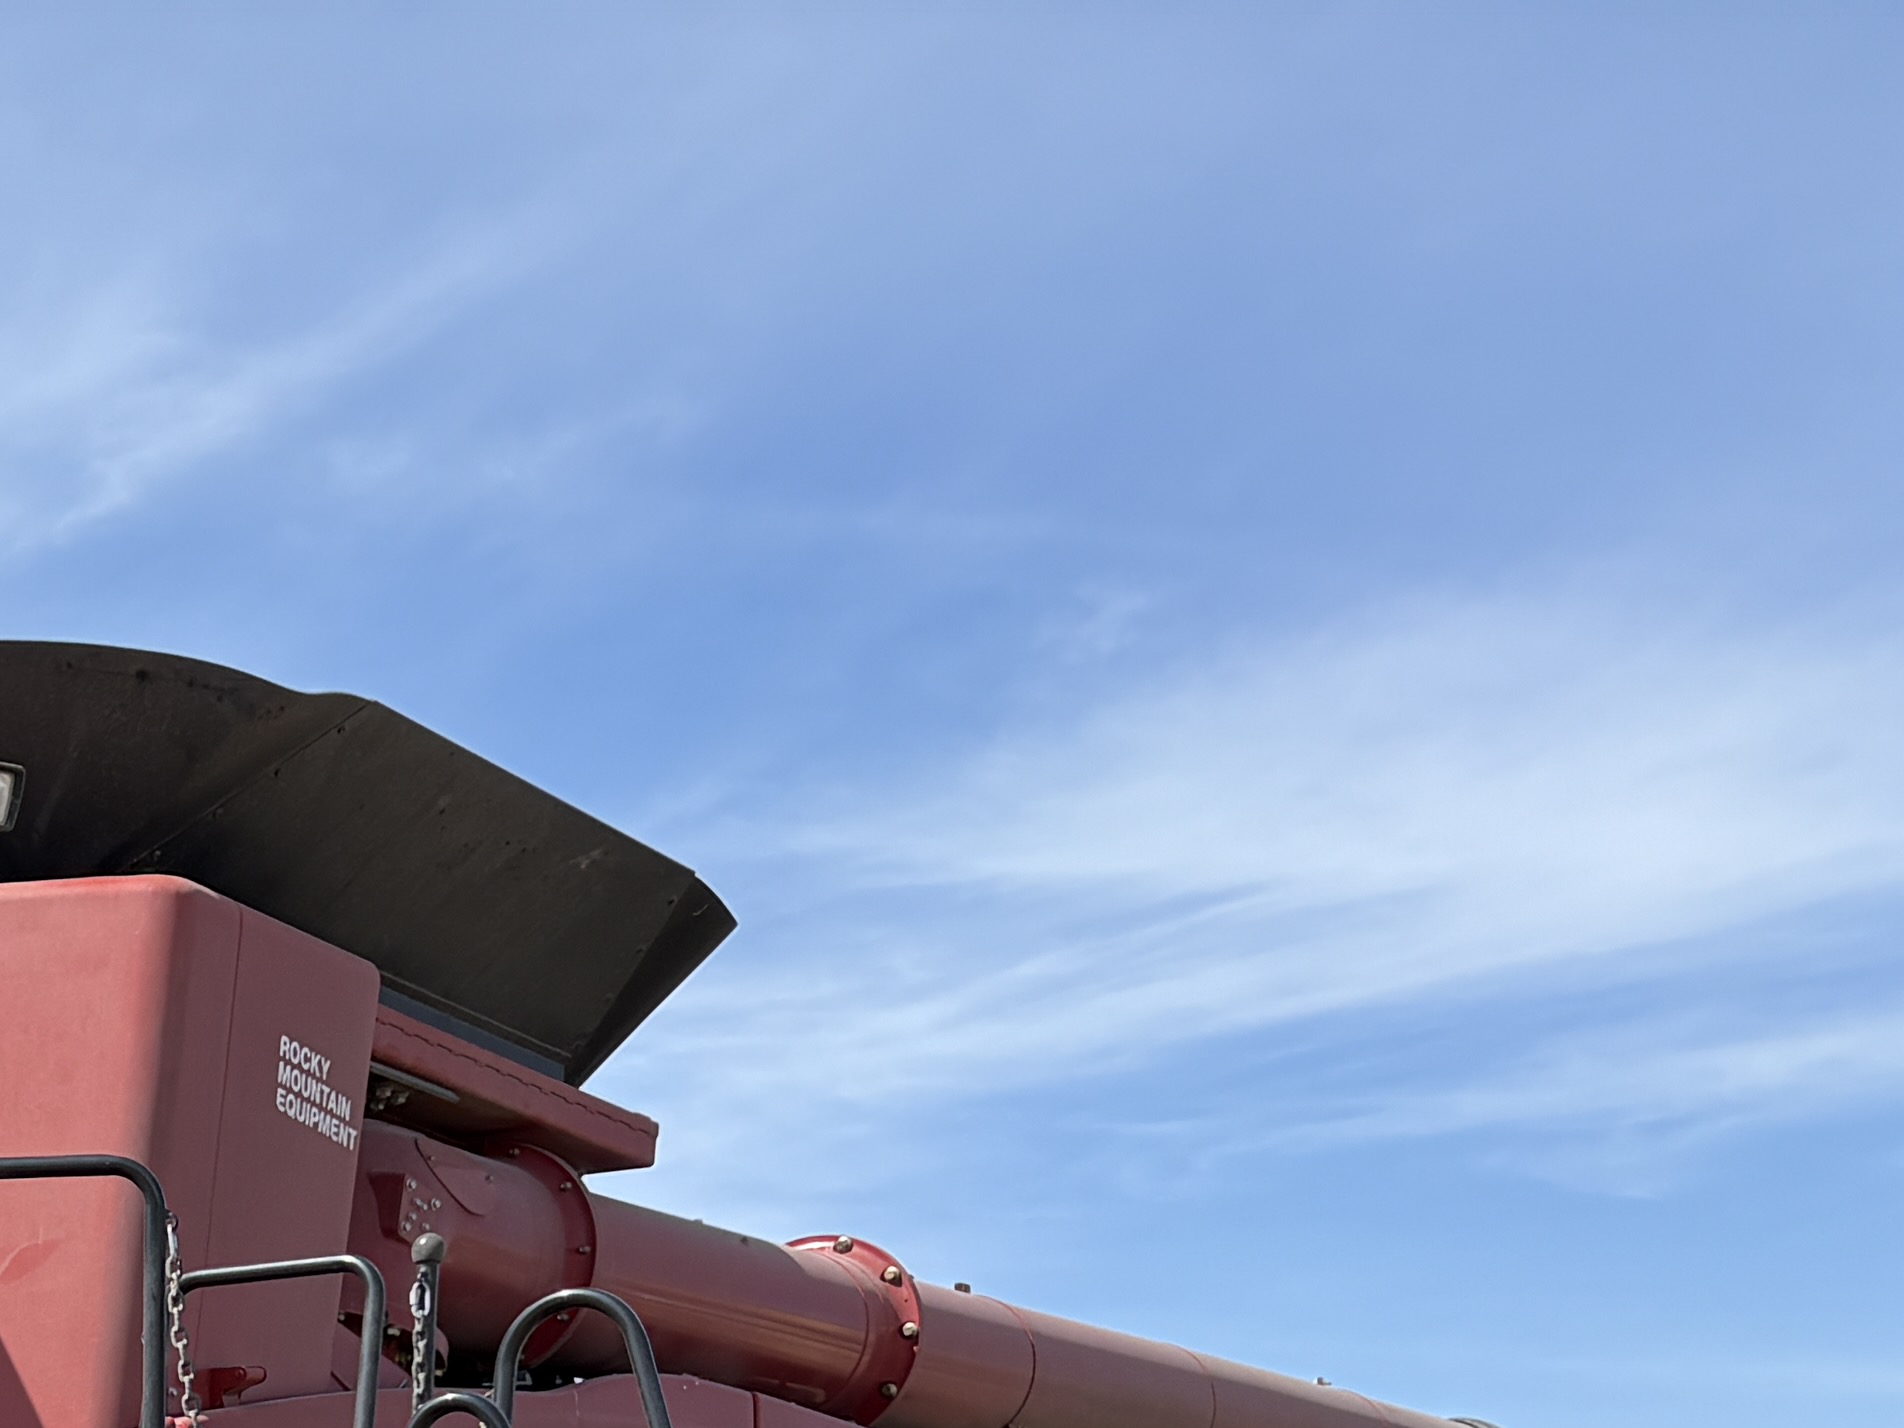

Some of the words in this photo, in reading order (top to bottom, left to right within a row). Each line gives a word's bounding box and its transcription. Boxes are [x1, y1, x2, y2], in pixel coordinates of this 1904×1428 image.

[279, 1034, 331, 1081] ROCKY
[275, 1087, 358, 1151] EQUIPMENT
[277, 1061, 352, 1121] MOUNTAIN
